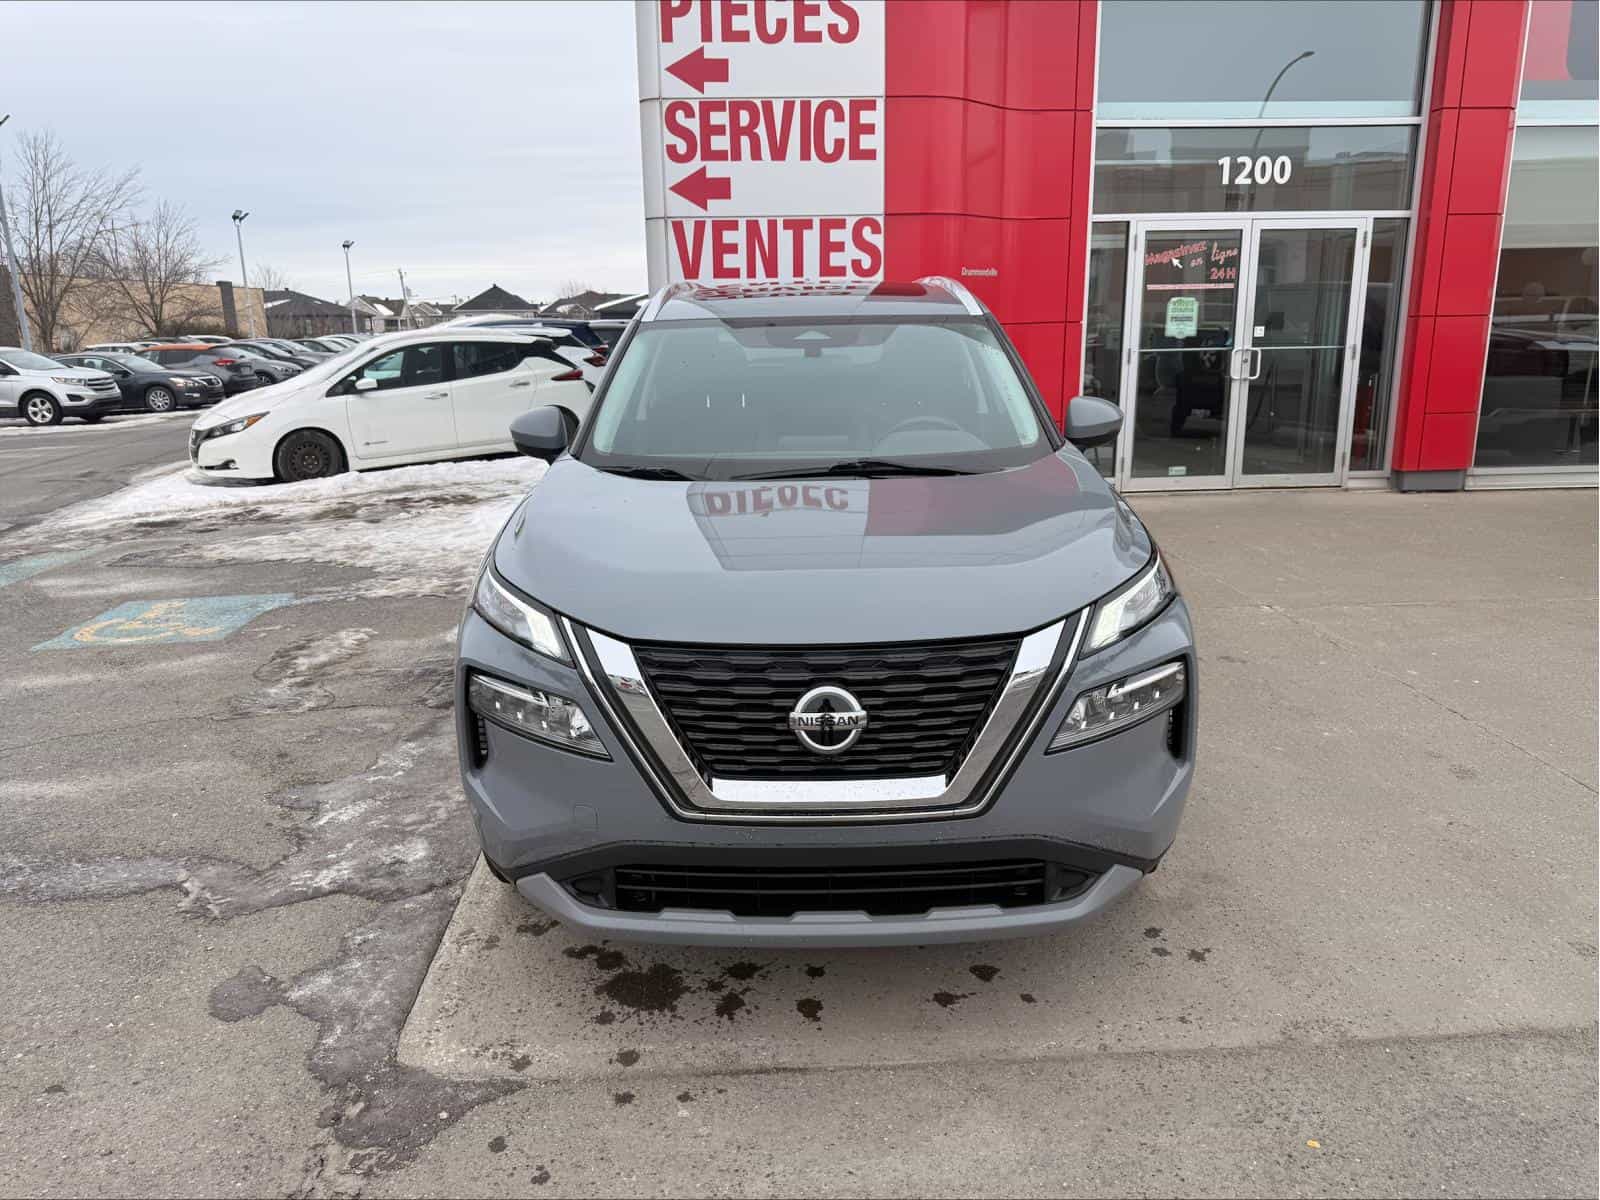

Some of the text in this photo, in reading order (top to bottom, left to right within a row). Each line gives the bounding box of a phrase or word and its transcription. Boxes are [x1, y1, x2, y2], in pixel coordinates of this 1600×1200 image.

[664, 99, 877, 164] SERVICE
[1217, 155, 1292, 185] 1200
[672, 217, 882, 280] VENTES
[798, 715, 859, 727] NISSAN
